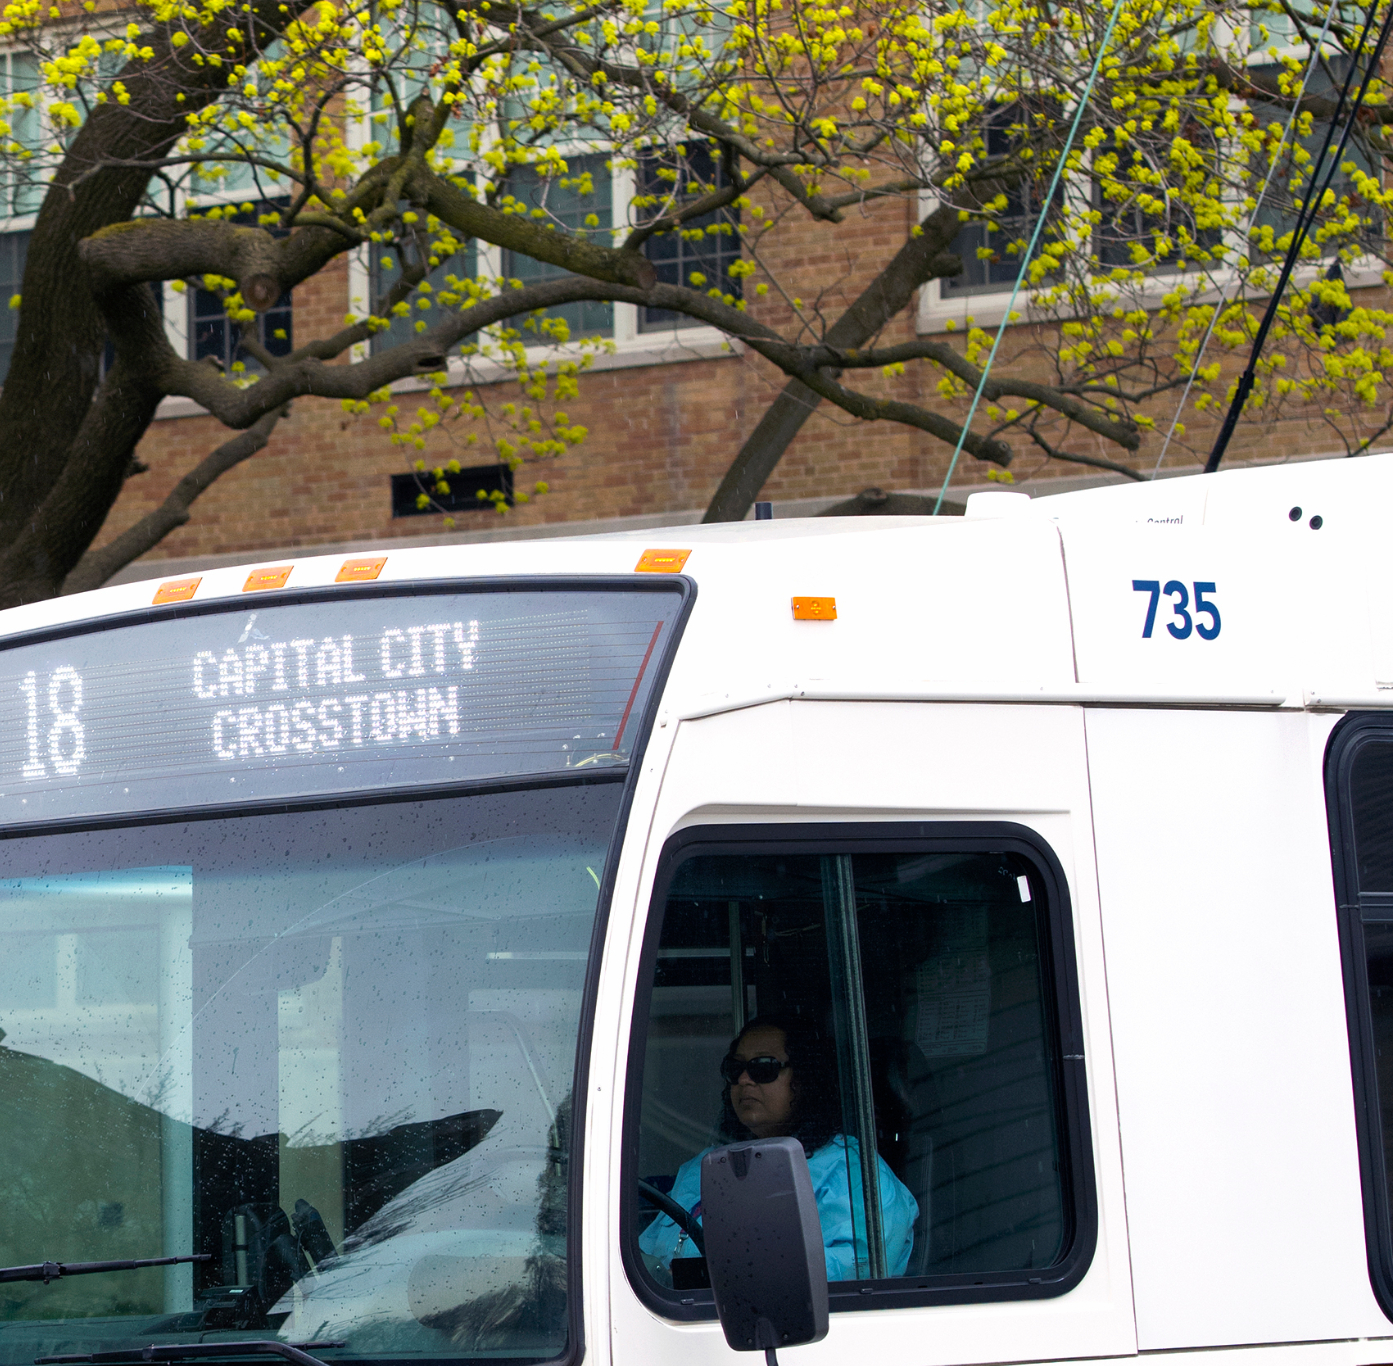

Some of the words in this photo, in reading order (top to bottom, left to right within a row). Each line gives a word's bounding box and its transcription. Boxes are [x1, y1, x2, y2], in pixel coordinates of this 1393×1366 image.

[1132, 579, 1221, 641] 735
[192, 634, 365, 698] CAPITAL
[381, 620, 480, 678] CITY
[20, 665, 85, 778] 18
[211, 686, 460, 759] CROSSTOWN
